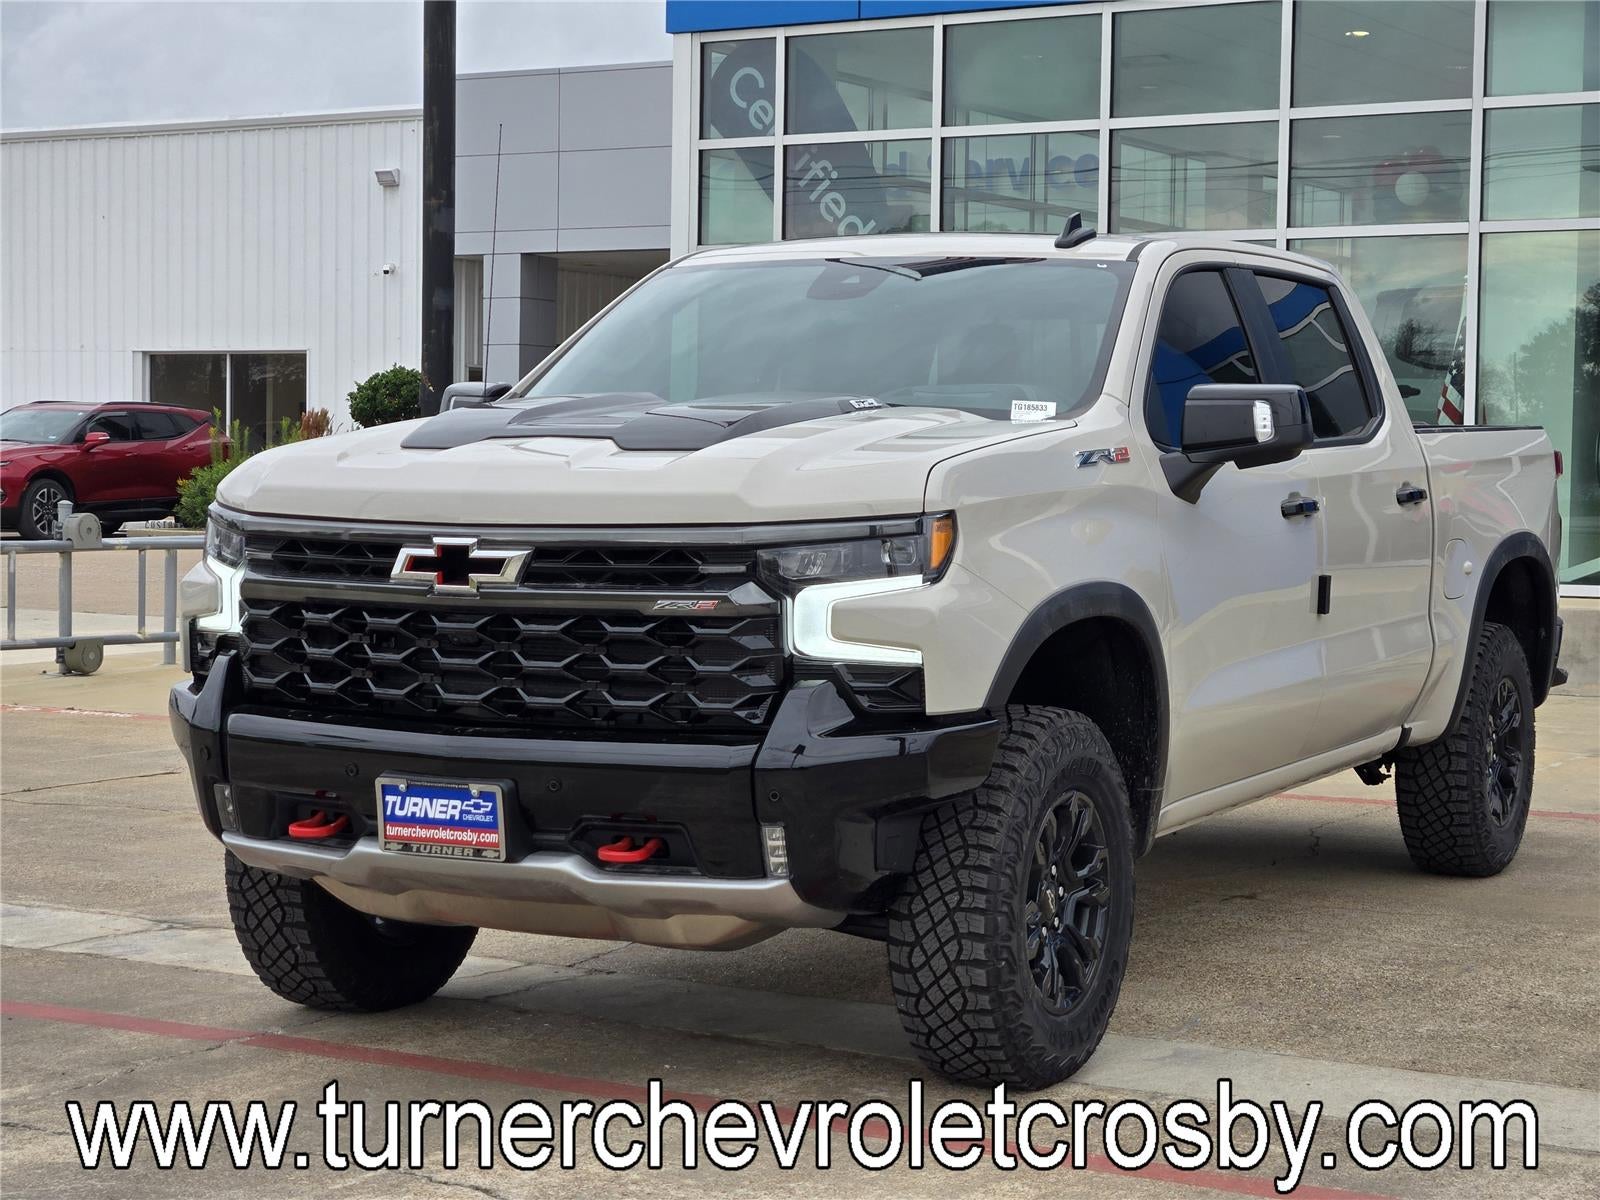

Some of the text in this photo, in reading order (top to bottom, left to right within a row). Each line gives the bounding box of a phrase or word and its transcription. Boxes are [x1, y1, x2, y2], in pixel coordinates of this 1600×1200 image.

[1073, 446, 1130, 469] ZR2
[653, 599, 720, 610] ZR2
[385, 795, 462, 820] TURNER
[462, 813, 494, 823] CHEVROLET
[386, 823, 499, 845] turnerchevroletcrosby.com
[411, 844, 474, 858] TURNER
